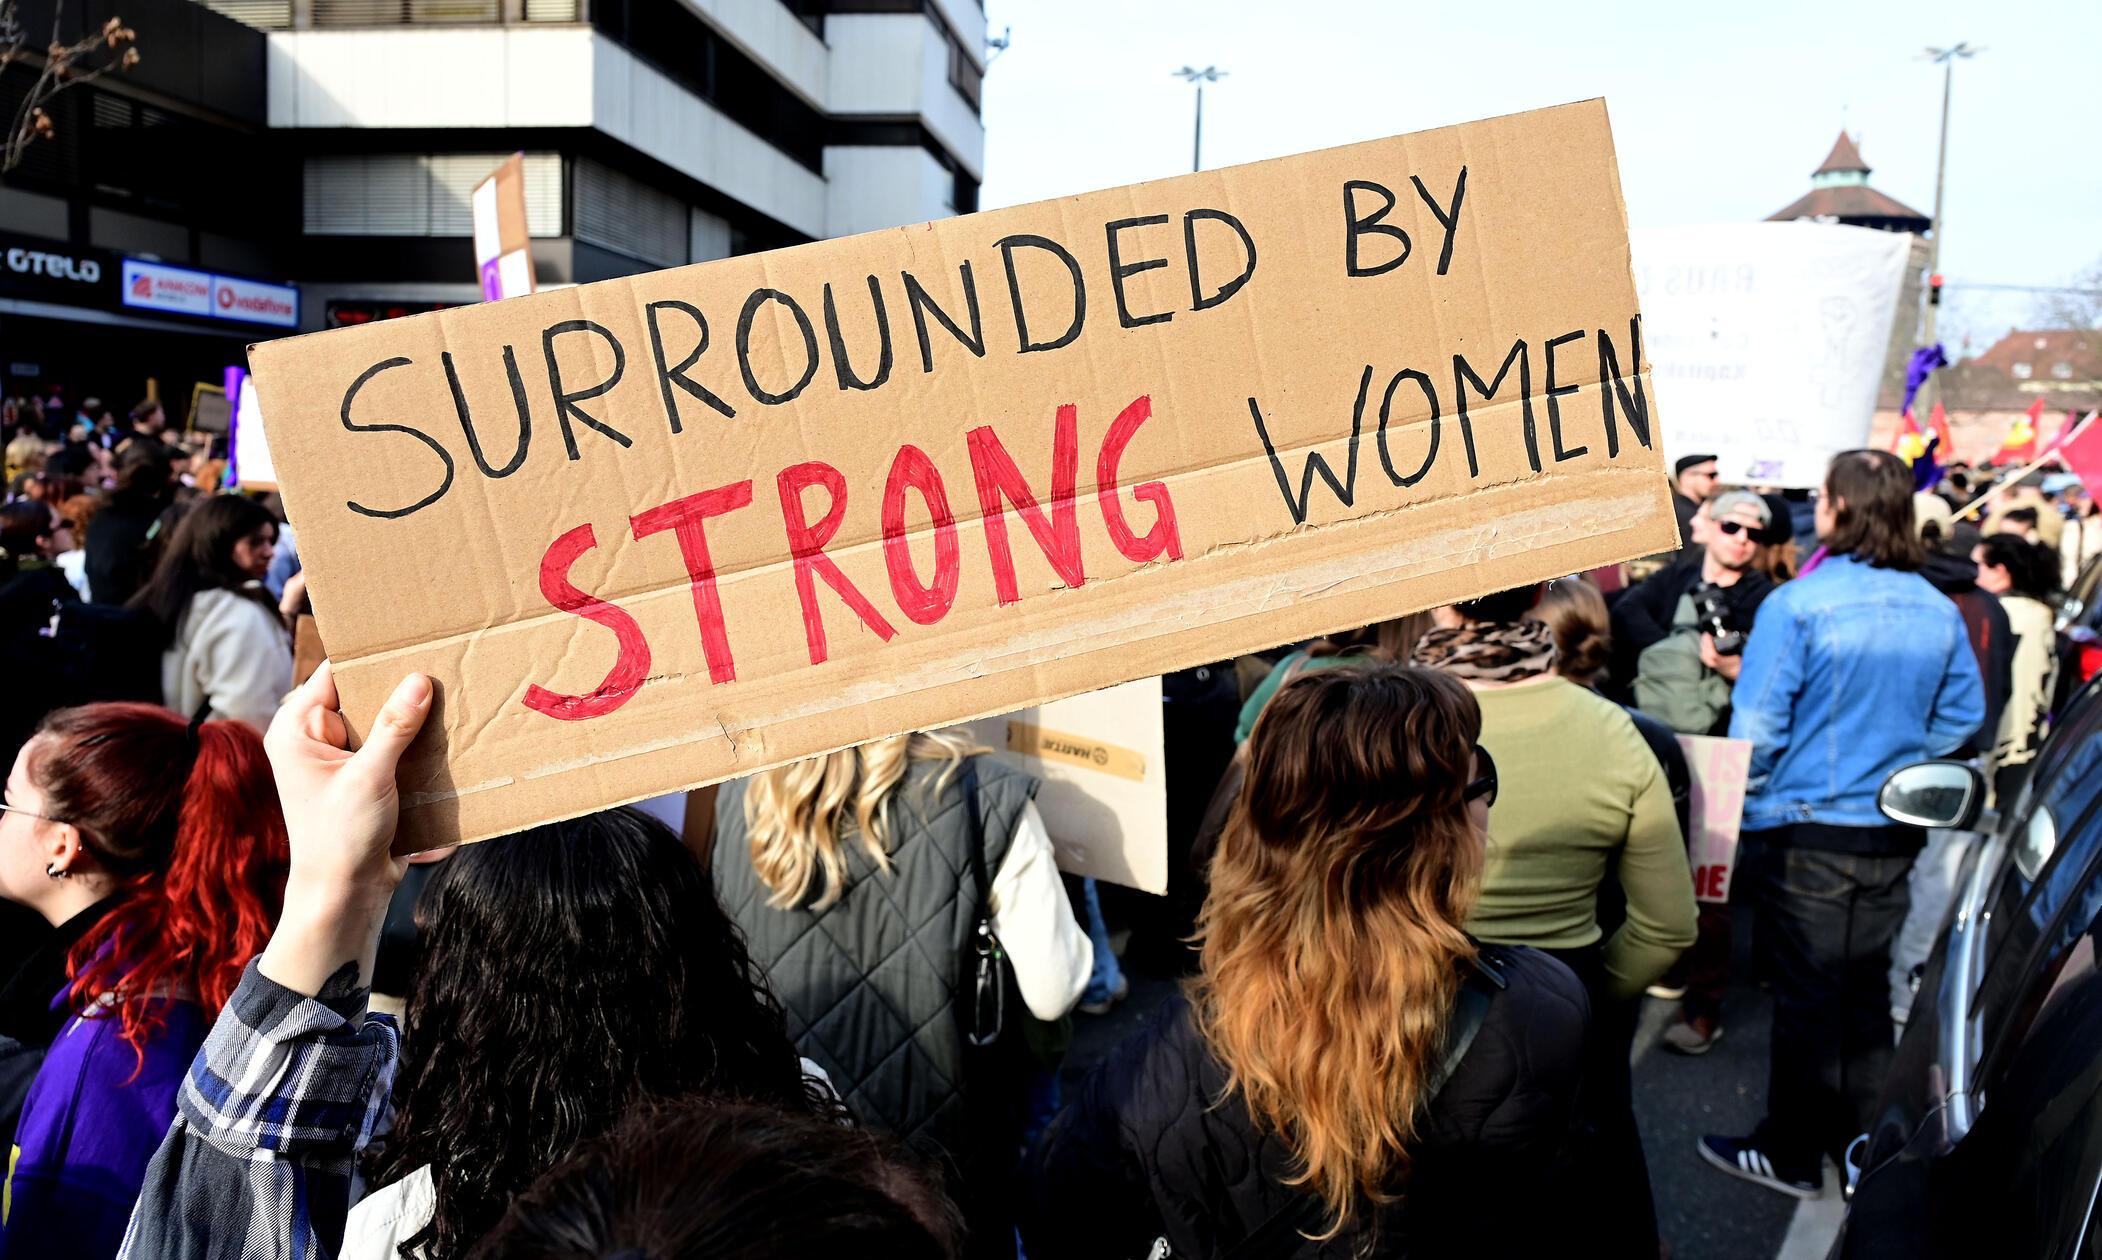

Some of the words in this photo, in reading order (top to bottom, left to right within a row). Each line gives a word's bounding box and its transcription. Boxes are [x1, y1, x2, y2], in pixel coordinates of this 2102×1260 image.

[340, 208, 1257, 519] SURROUNDED
[1343, 165, 1468, 278] BY
[521, 394, 1185, 721] STRONG
[1248, 312, 1652, 525] WOMEN
